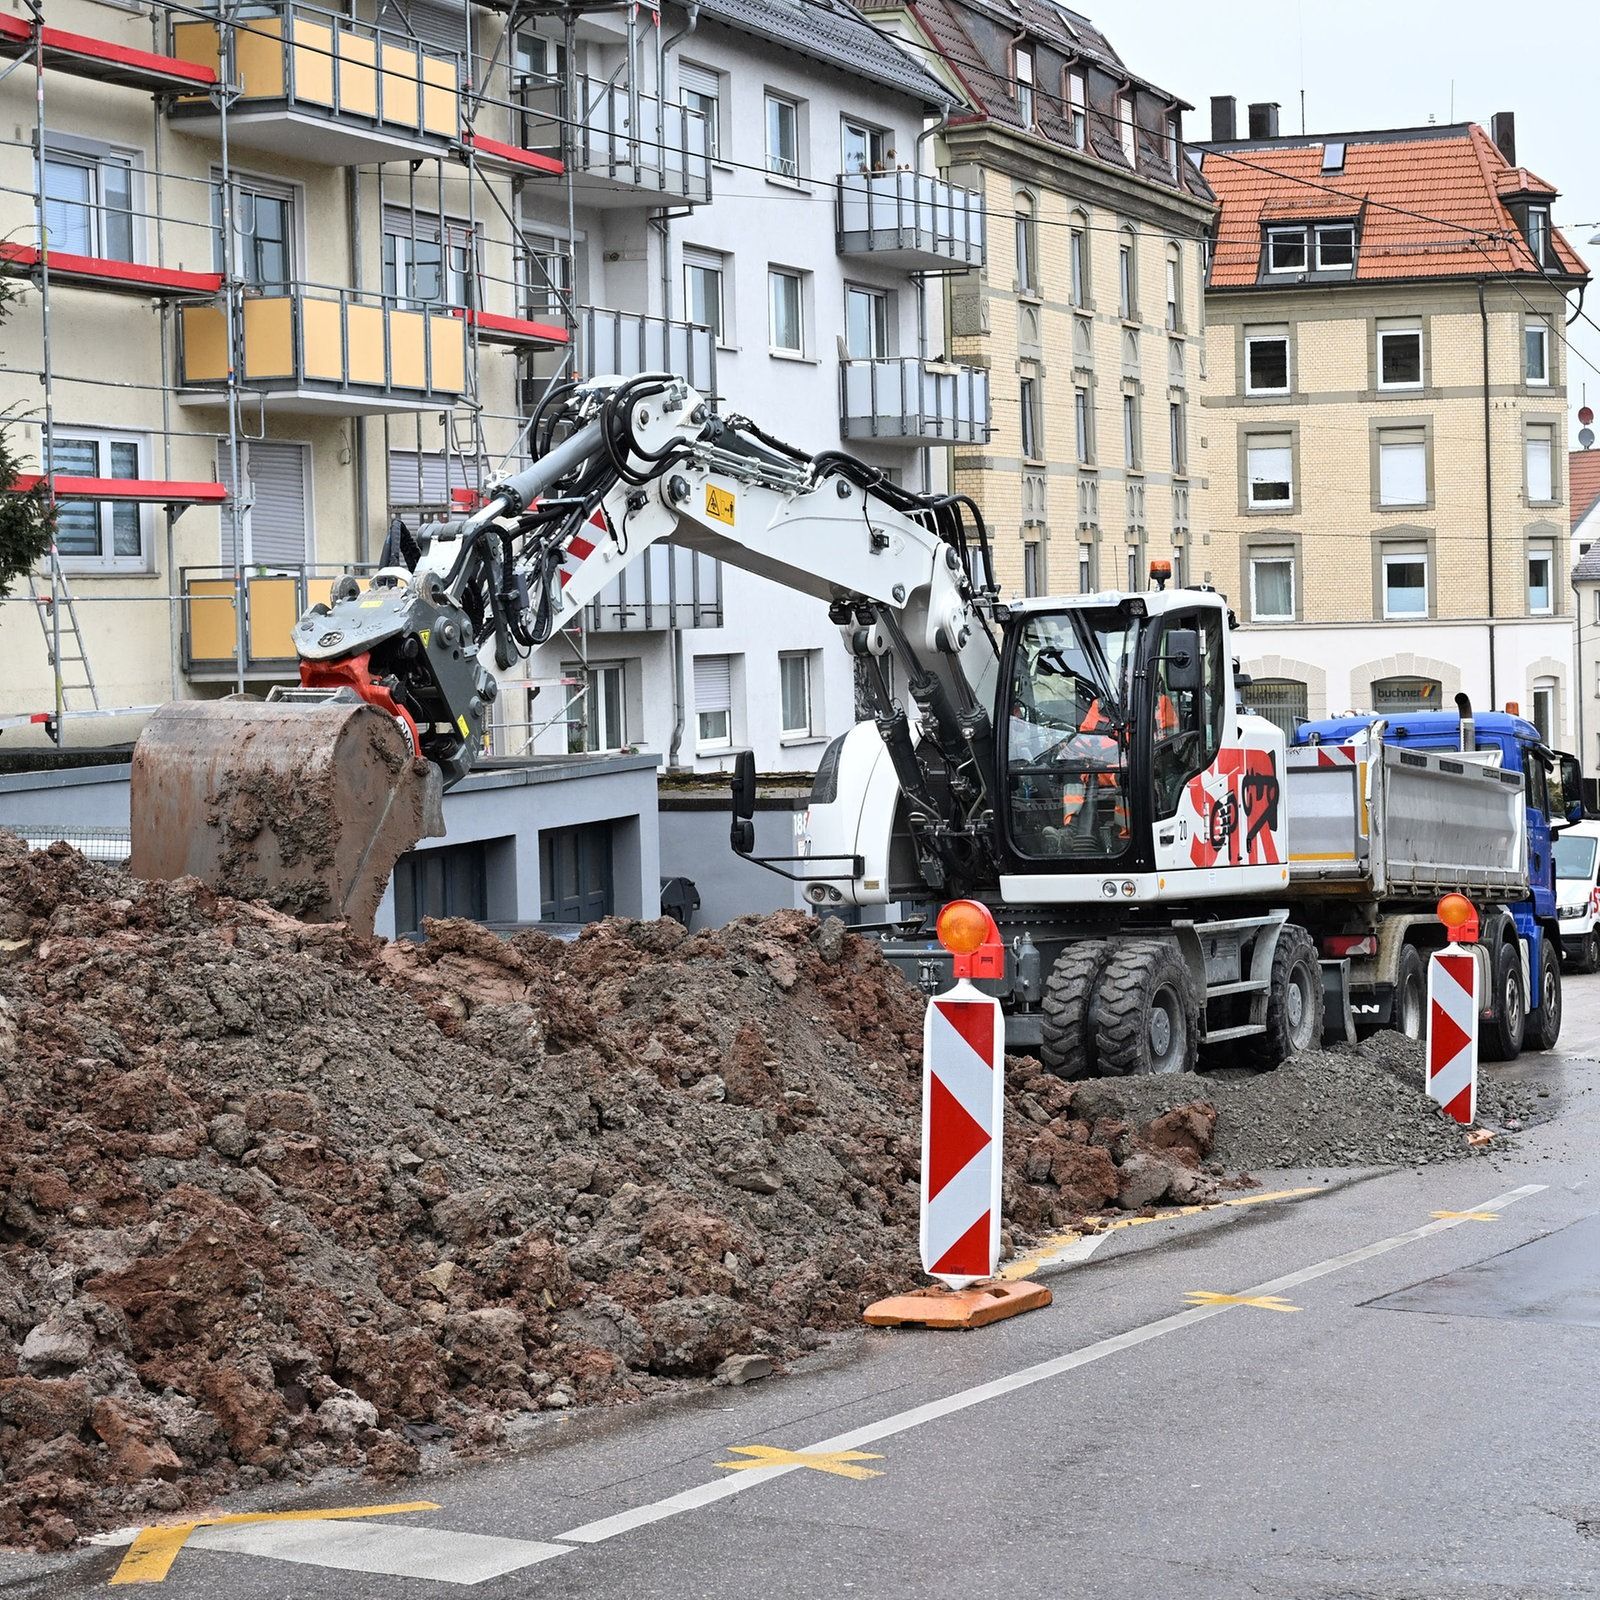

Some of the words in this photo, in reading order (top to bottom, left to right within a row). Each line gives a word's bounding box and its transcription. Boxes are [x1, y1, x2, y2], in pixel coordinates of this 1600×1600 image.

[1378, 688, 1421, 698] buchner
[1179, 820, 1187, 840] 20
[1350, 1004, 1380, 1013] AN
